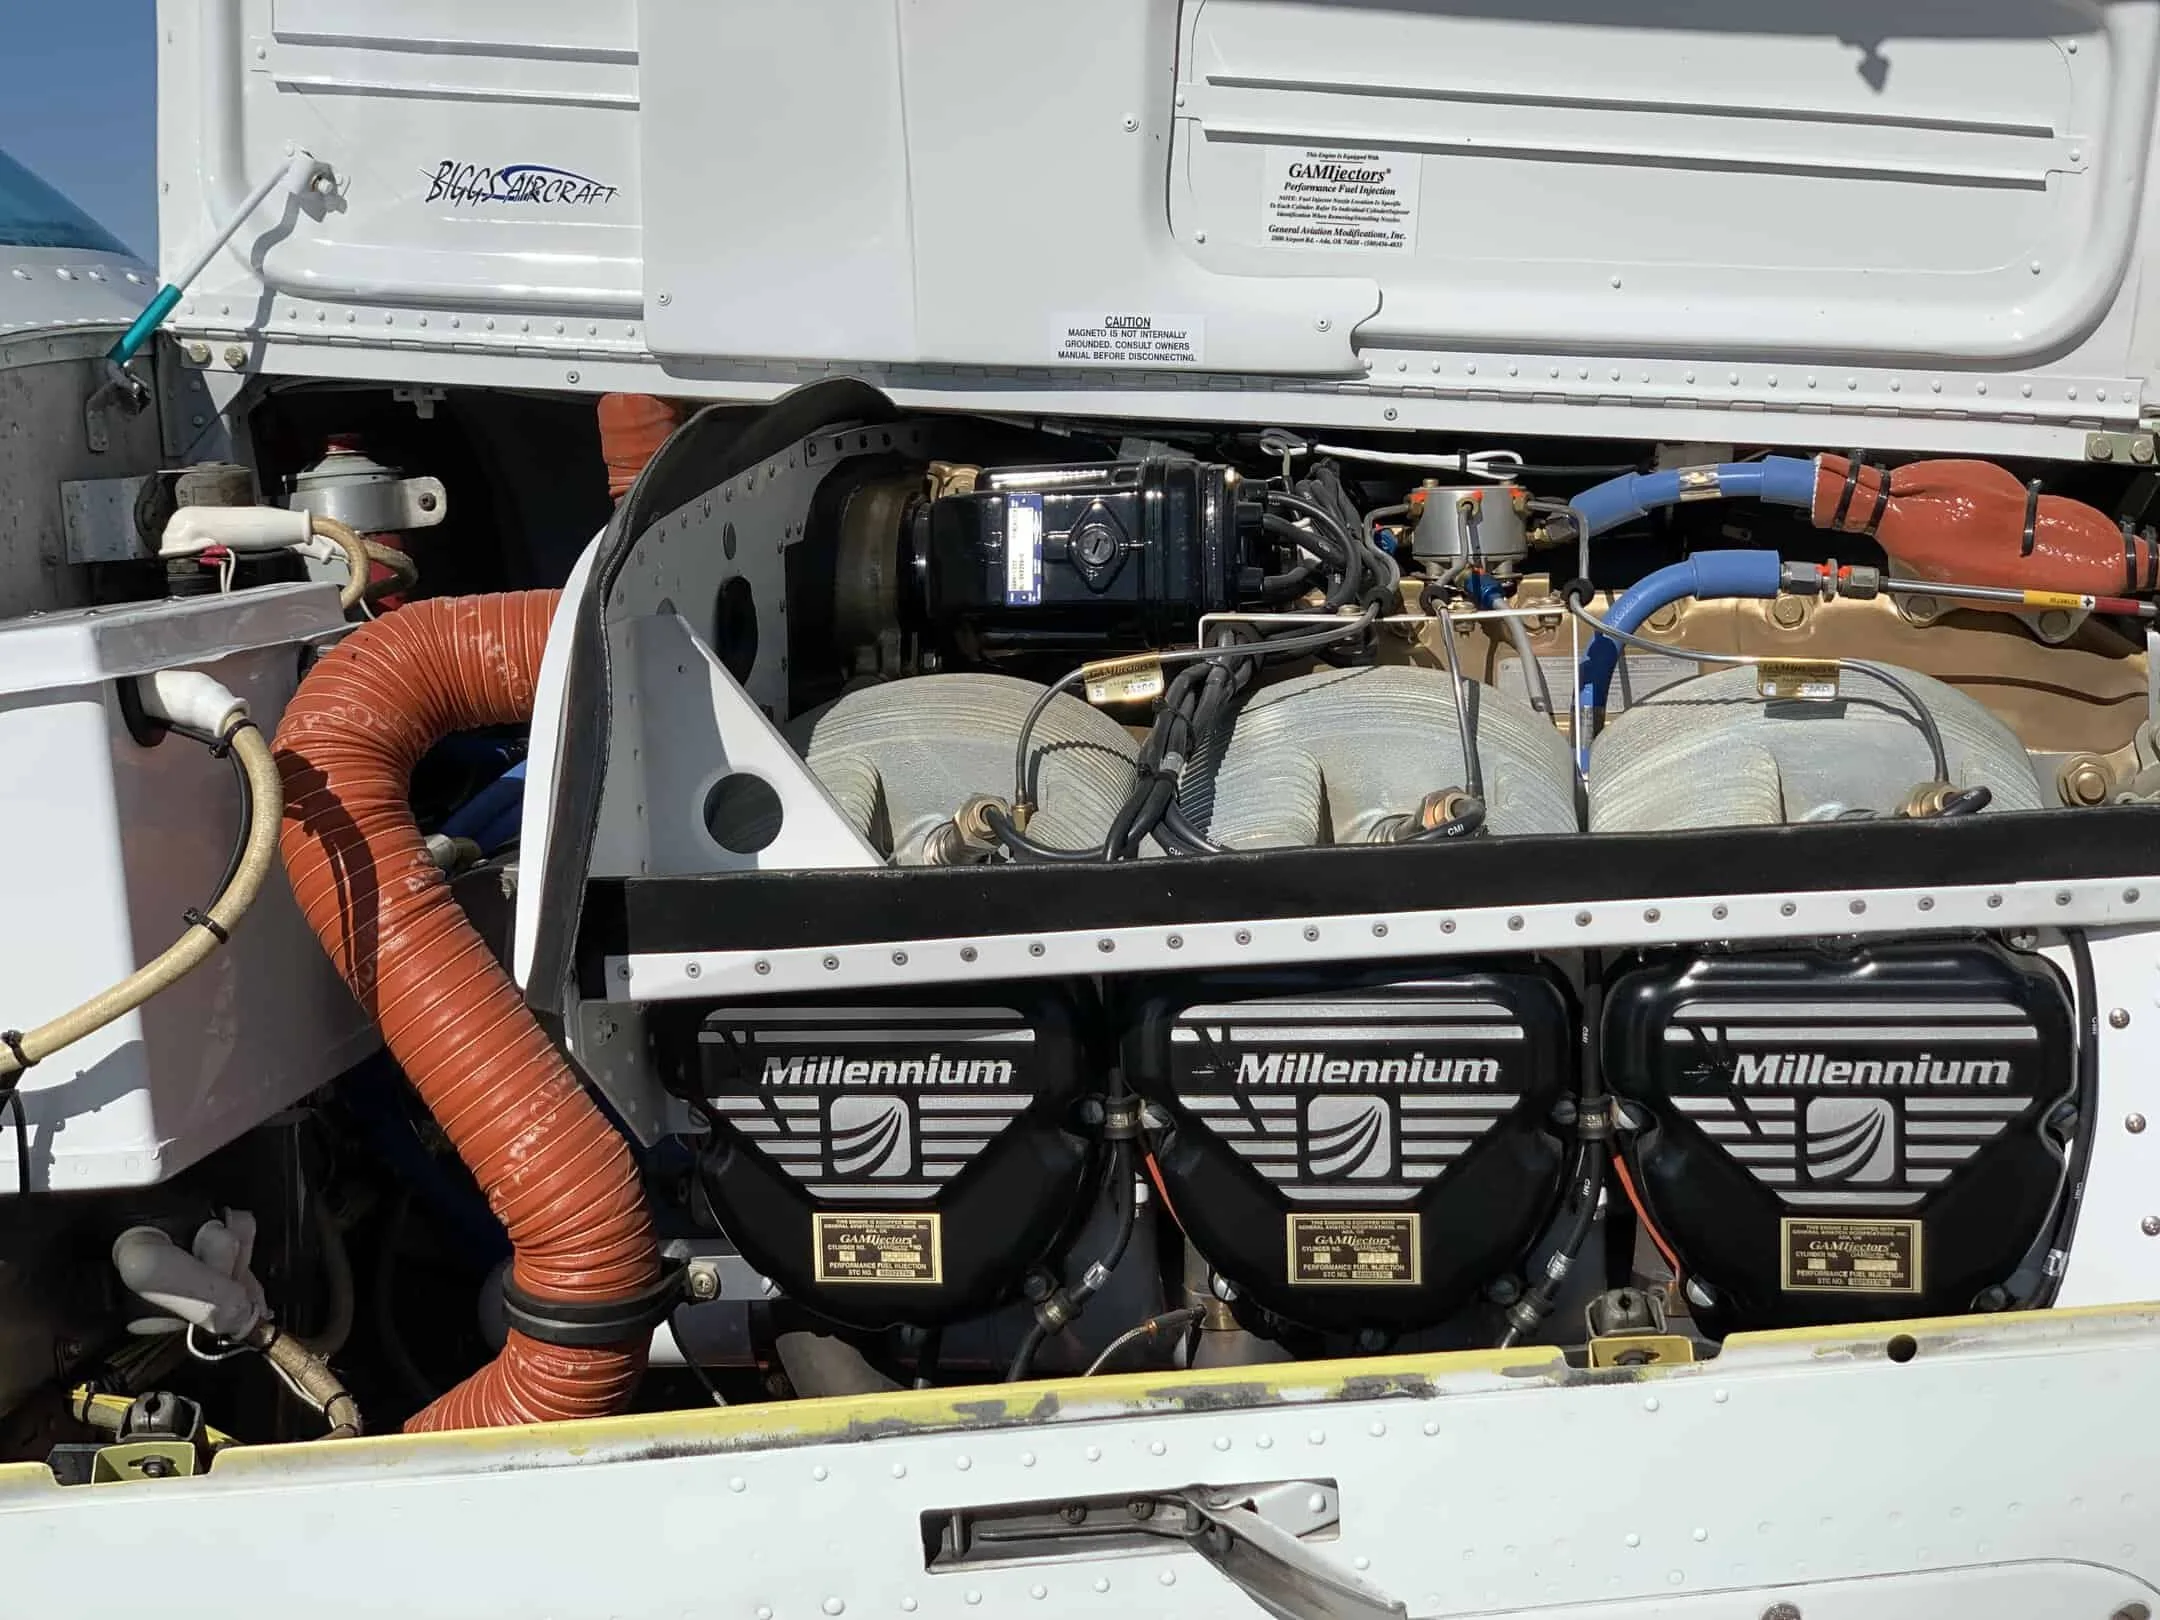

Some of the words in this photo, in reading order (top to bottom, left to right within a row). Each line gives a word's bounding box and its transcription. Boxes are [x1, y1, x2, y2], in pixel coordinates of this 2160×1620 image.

[425, 160, 502, 208] BIGGS
[504, 172, 617, 205] AIRCRAFT
[1284, 182, 1336, 194] Performance
[1338, 184, 1358, 194] Fuel
[1359, 185, 1396, 196] Injection
[1268, 224, 1300, 234] General
[1300, 226, 1332, 236] Aviation
[1334, 226, 1389, 240] Modifications,
[1390, 230, 1407, 240] Inc.
[1104, 316, 1150, 328] CAUTION
[1068, 328, 1107, 338] MAGNETO
[1110, 330, 1118, 338] IS
[1122, 330, 1137, 338] NOT
[1140, 330, 1188, 340] INTERNALLY
[1064, 340, 1112, 348] GROUNDED.
[1115, 340, 1152, 350] CONSULT
[1154, 342, 1190, 350] OWNERS
[1058, 351, 1090, 360] MANUAL
[1094, 352, 1126, 360] BEFORE
[1128, 352, 1197, 362] DISCONNECTING.
[1448, 823, 1465, 837] CMI
[760, 1053, 1013, 1085] Millennium
[1236, 1051, 1500, 1085] Millennium
[1732, 1054, 2011, 1086] Millennium
[1796, 1270, 1848, 1278] PERFORMANCE
[1867, 1271, 1904, 1279] INJECTION
